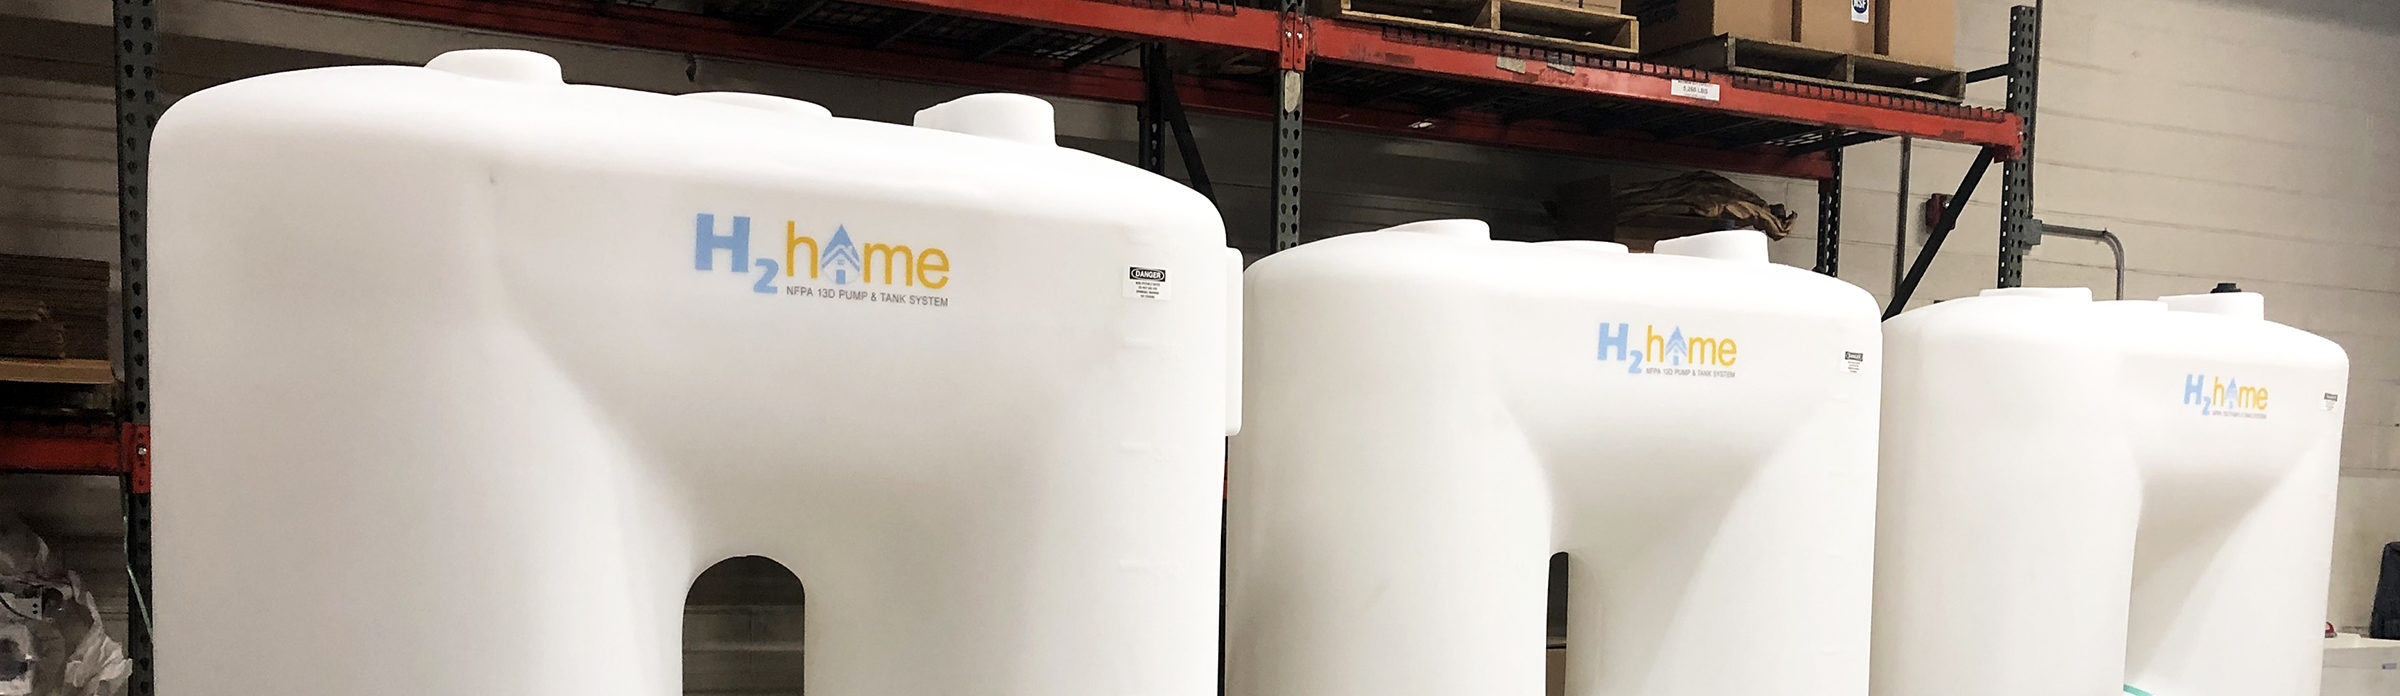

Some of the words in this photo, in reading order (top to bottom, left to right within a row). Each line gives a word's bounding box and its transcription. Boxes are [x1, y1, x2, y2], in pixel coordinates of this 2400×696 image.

[1135, 270, 1161, 279] DANGER
[786, 286, 813, 296] NFPA
[818, 288, 835, 299] 13D
[838, 289, 868, 301] PUMP
[870, 292, 877, 302] &
[880, 292, 906, 304] TANK
[909, 295, 949, 307] SYSTEM
